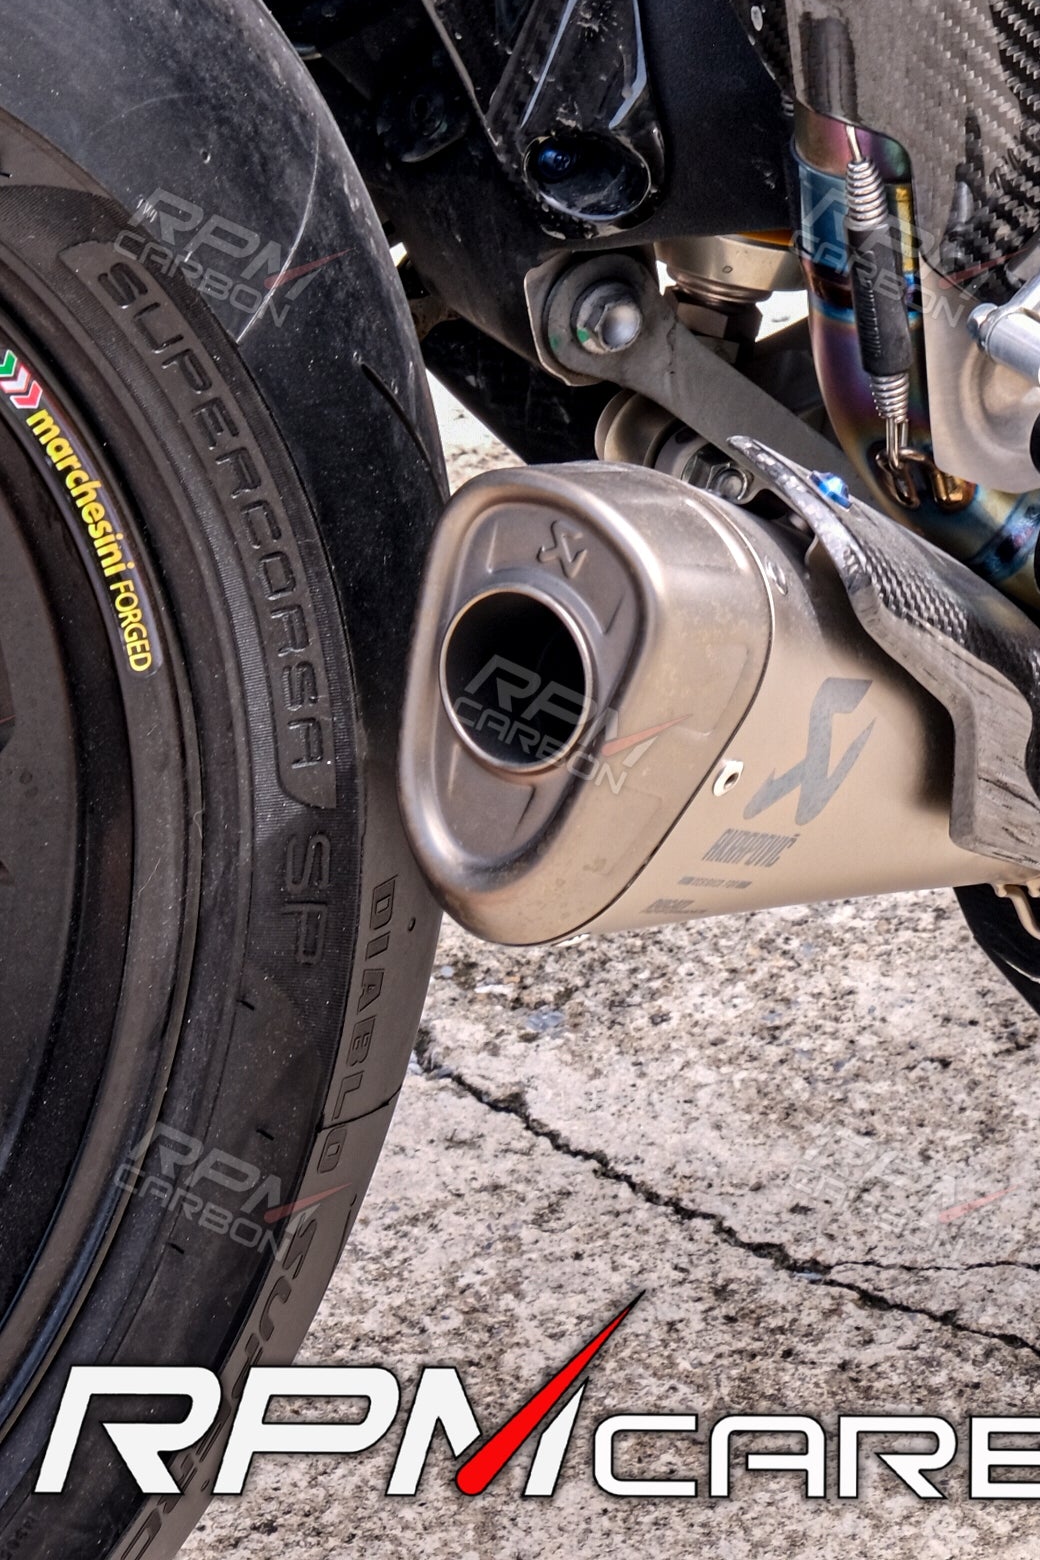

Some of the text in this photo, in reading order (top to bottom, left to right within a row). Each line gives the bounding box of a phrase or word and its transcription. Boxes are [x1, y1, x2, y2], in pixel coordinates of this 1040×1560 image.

[26, 409, 152, 673] marchesini FORGED
[97, 261, 331, 965] SUPERCORSA SP
[317, 874, 399, 1174] DIABLO
